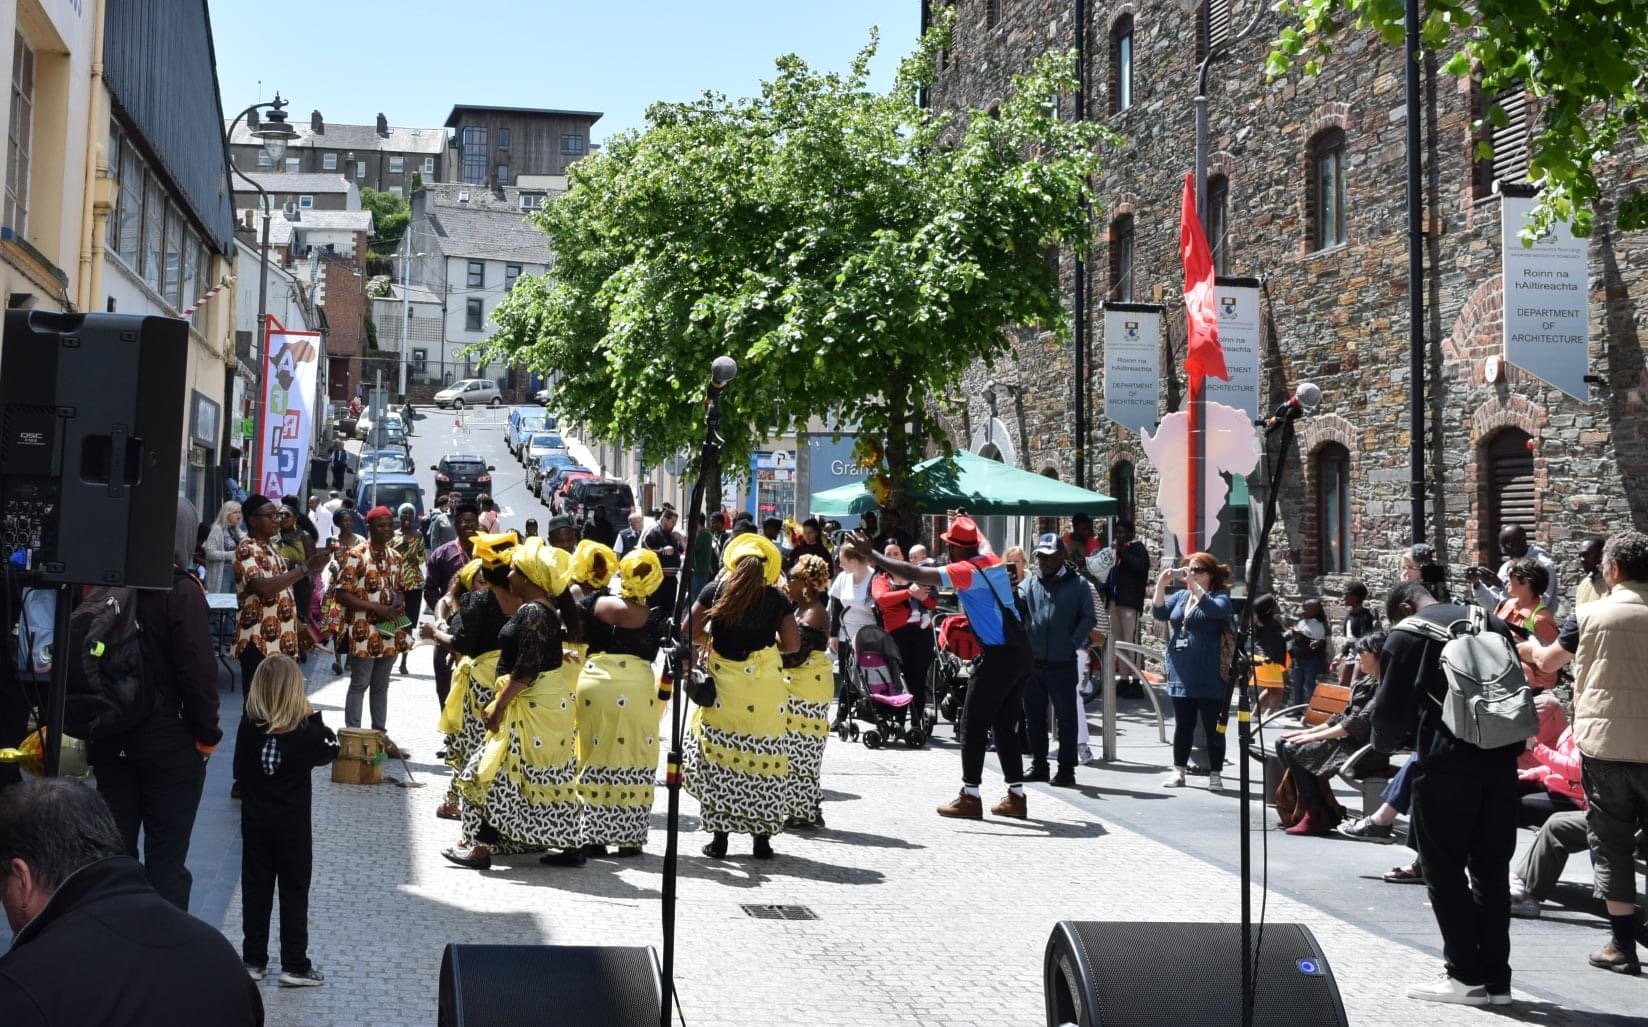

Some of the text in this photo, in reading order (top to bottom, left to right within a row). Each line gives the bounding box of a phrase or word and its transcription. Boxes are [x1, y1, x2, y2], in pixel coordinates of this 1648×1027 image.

[1523, 268, 1569, 279] Roinn na
[1515, 281, 1578, 291] hAiltireachta
[1517, 308, 1580, 317] DEPARTMENT
[1542, 321, 1555, 330] OF
[1217, 336, 1234, 345] oinn
[1511, 334, 1584, 344] ARCHITECTURE
[1117, 357, 1137, 365] Roinn
[1109, 398, 1154, 406] ARCHITECTURE
